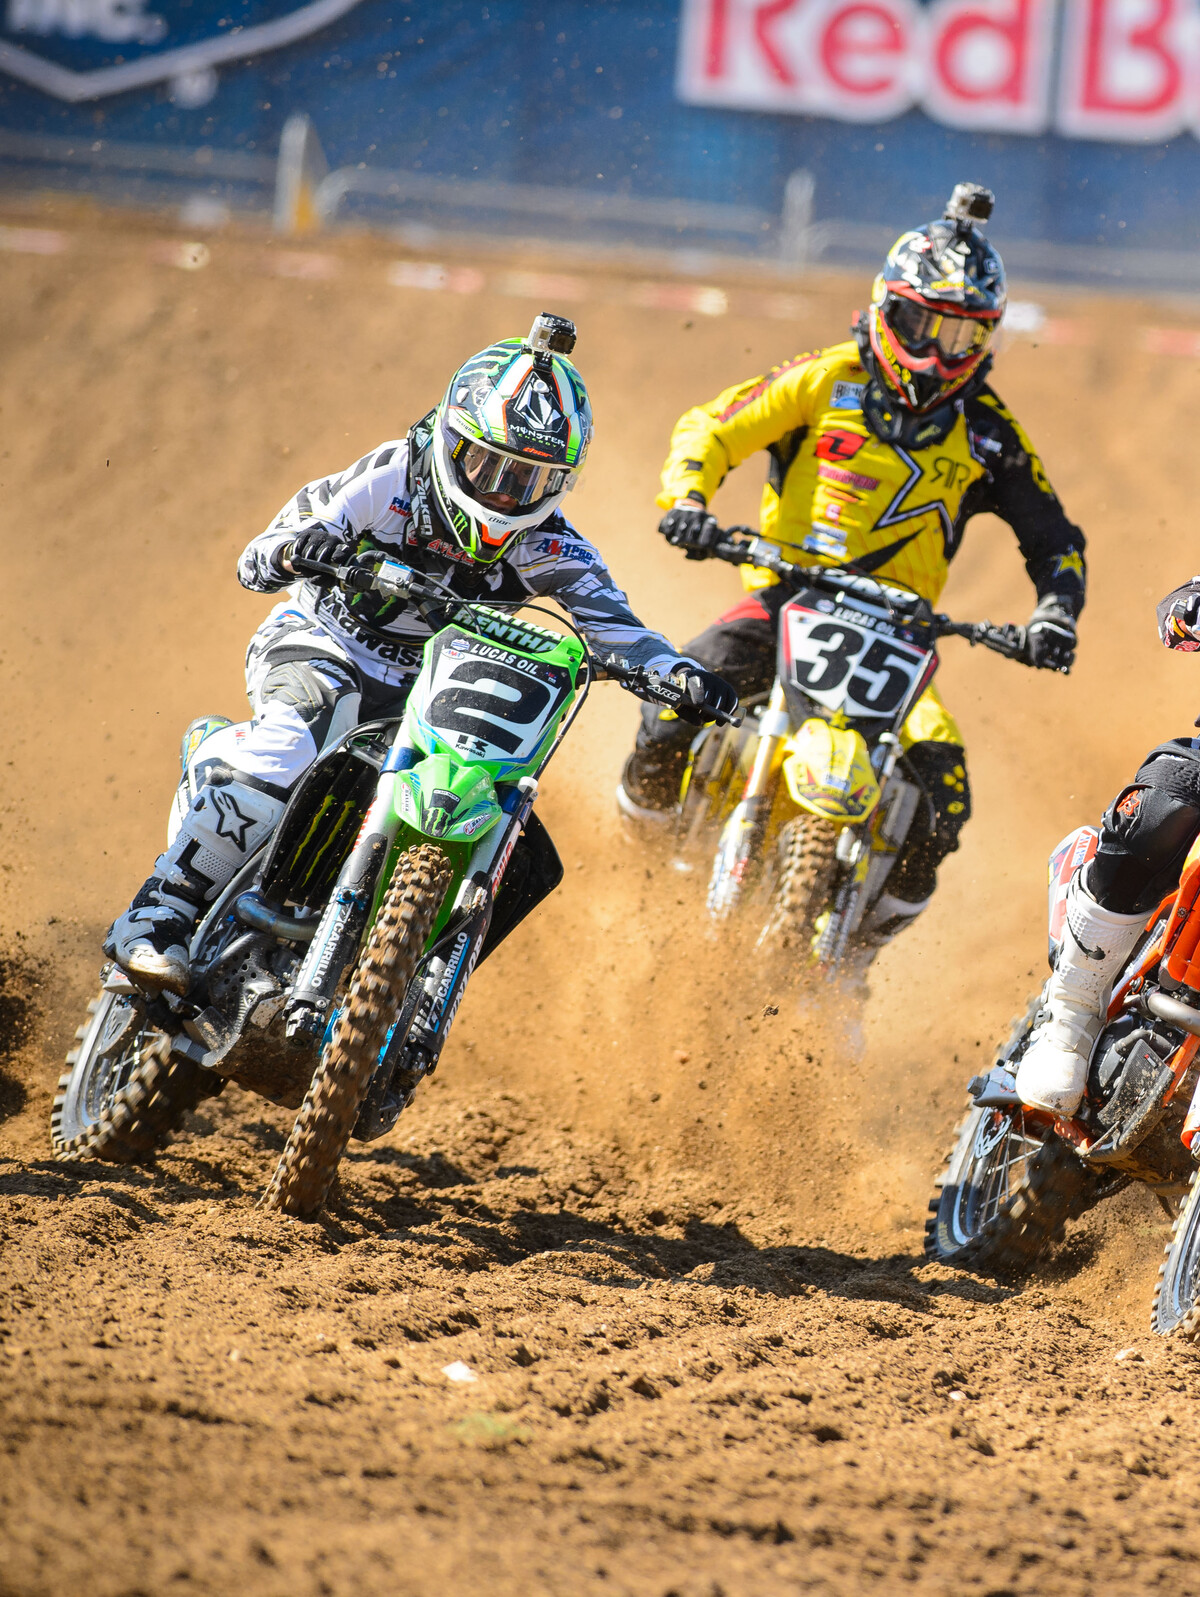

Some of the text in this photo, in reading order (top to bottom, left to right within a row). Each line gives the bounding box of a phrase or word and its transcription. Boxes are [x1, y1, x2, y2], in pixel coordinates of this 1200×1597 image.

[703, 0, 1026, 106] Red
[508, 424, 566, 448] MONSTER
[452, 610, 560, 653] RENTHA
[468, 602, 568, 642] ENTHA
[469, 643, 541, 676] LUCAS OIL
[795, 622, 921, 713] 35
[424, 659, 551, 755] 2
[646, 683, 681, 702] ARC
[454, 742, 487, 759] Kawasaki
[311, 921, 345, 988] CARRILLO
[436, 930, 468, 996] CARRILLO
